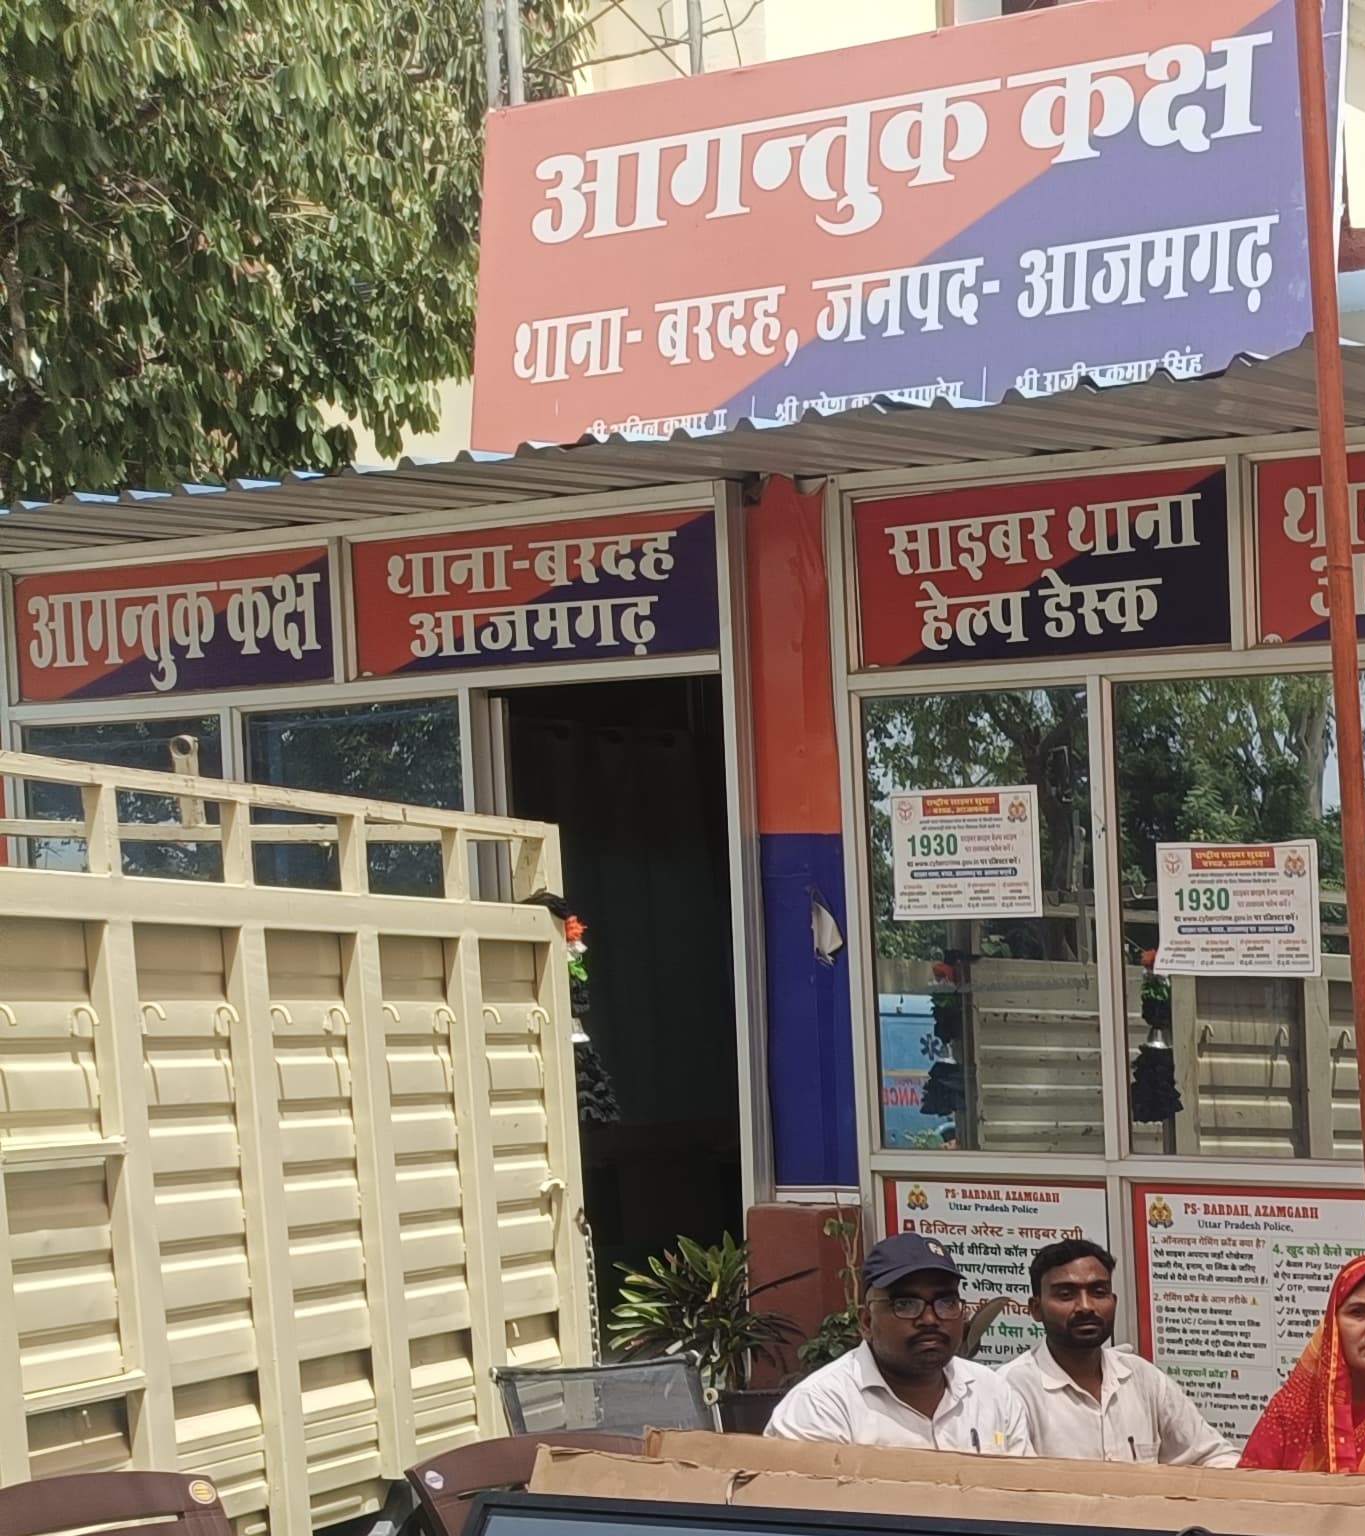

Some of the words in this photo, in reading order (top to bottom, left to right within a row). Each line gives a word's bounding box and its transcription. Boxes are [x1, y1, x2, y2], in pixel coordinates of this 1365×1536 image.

[531, 78, 1001, 245] आगन्तुक
[1007, 31, 1275, 166] कक्ष
[513, 305, 643, 385] थाना-
[654, 284, 799, 368] बरदह,
[811, 256, 1001, 343] जनपद-
[1018, 213, 1279, 316] आजमगढ़
[884, 509, 1055, 582] साइबर
[1067, 491, 1202, 557] थाना
[915, 579, 1027, 651] हेल्प
[1043, 567, 1162, 640] डेस्क
[27, 580, 218, 692] आगन्तुक
[219, 571, 320, 660] कक्ष
[410, 594, 659, 657] आजमगढ़
[907, 833, 958, 857] 1930
[1175, 887, 1230, 911] 1930
[1005, 1191, 1061, 1203] AZAMGARH
[949, 1202, 972, 1212] Uttar
[974, 1203, 1009, 1213] Pradesh
[1012, 1204, 1039, 1214] Police
[1254, 1205, 1319, 1219] AZAMGARH
[920, 1219, 967, 1236] डिजिटल
[971, 1222, 1004, 1238] अरेस्ट
[1018, 1227, 1057, 1240] साइबर
[1198, 1220, 1222, 1230] Uttar
[1224, 1220, 1261, 1231] Pradesh
[967, 1242, 1001, 1257] वीडियो
[1004, 1242, 1028, 1257] कॉल
[1306, 1243, 1320, 1256] को
[957, 1262, 1026, 1276] ाधार/पासपोर्ट
[1305, 1261, 1321, 1271] Play
[972, 1279, 1003, 1294] भेजिए
[1005, 1284, 1030, 1294] वरना
[998, 1320, 1024, 1338] पैसा
[995, 1345, 1014, 1355] UPI
